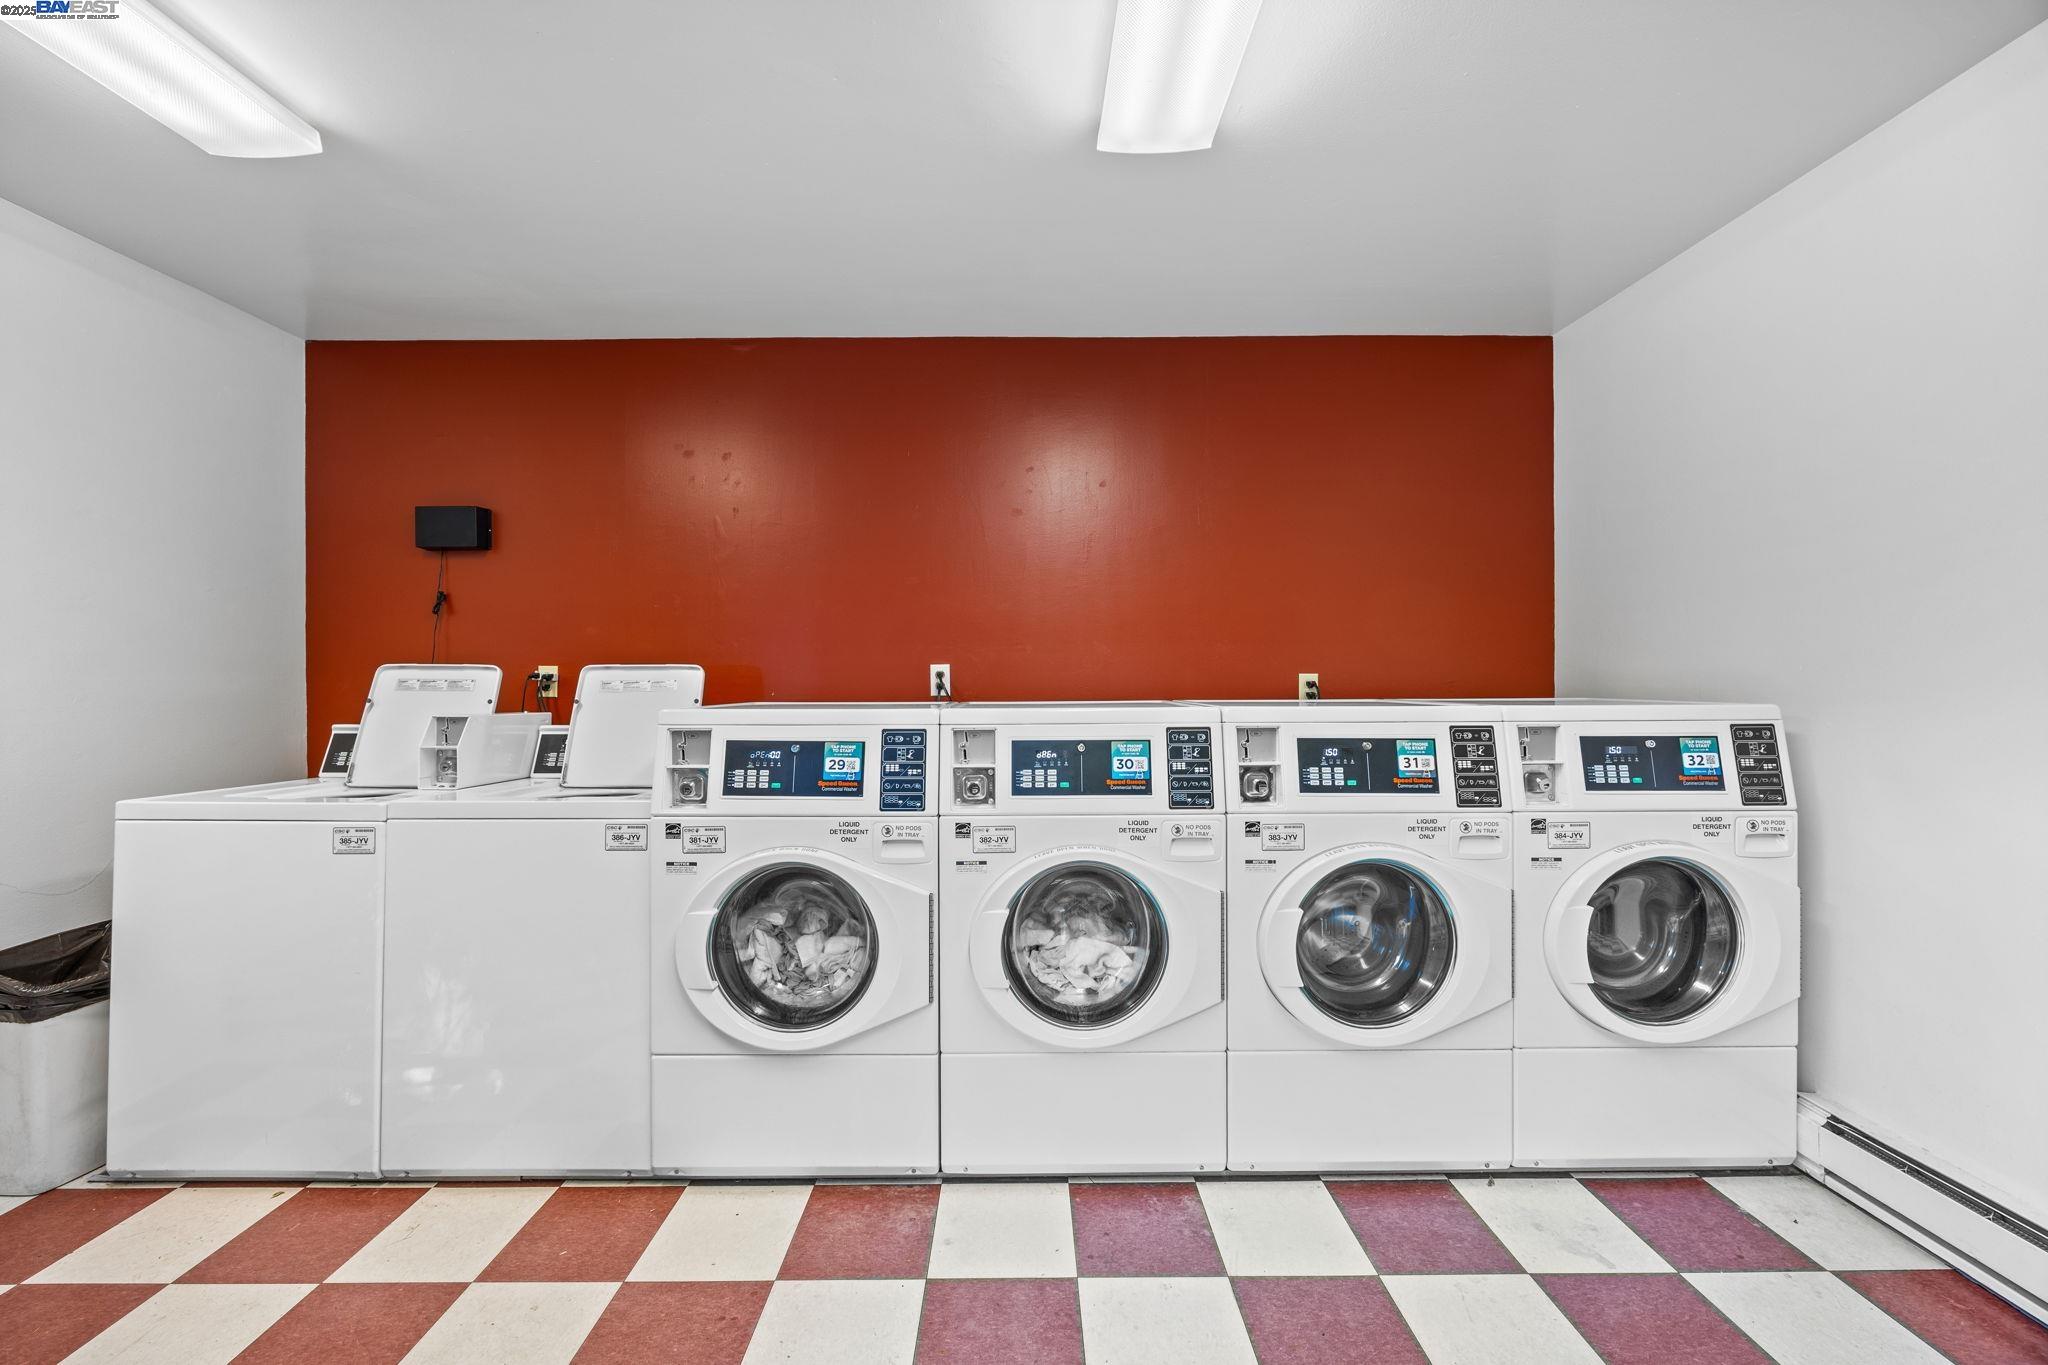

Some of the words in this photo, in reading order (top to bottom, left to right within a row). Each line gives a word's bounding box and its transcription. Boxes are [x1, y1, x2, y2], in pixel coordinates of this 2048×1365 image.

[828, 759, 846, 770] 29
[1116, 759, 1134, 769] 30
[1404, 757, 1418, 768] 31
[1687, 755, 1705, 766] 32
